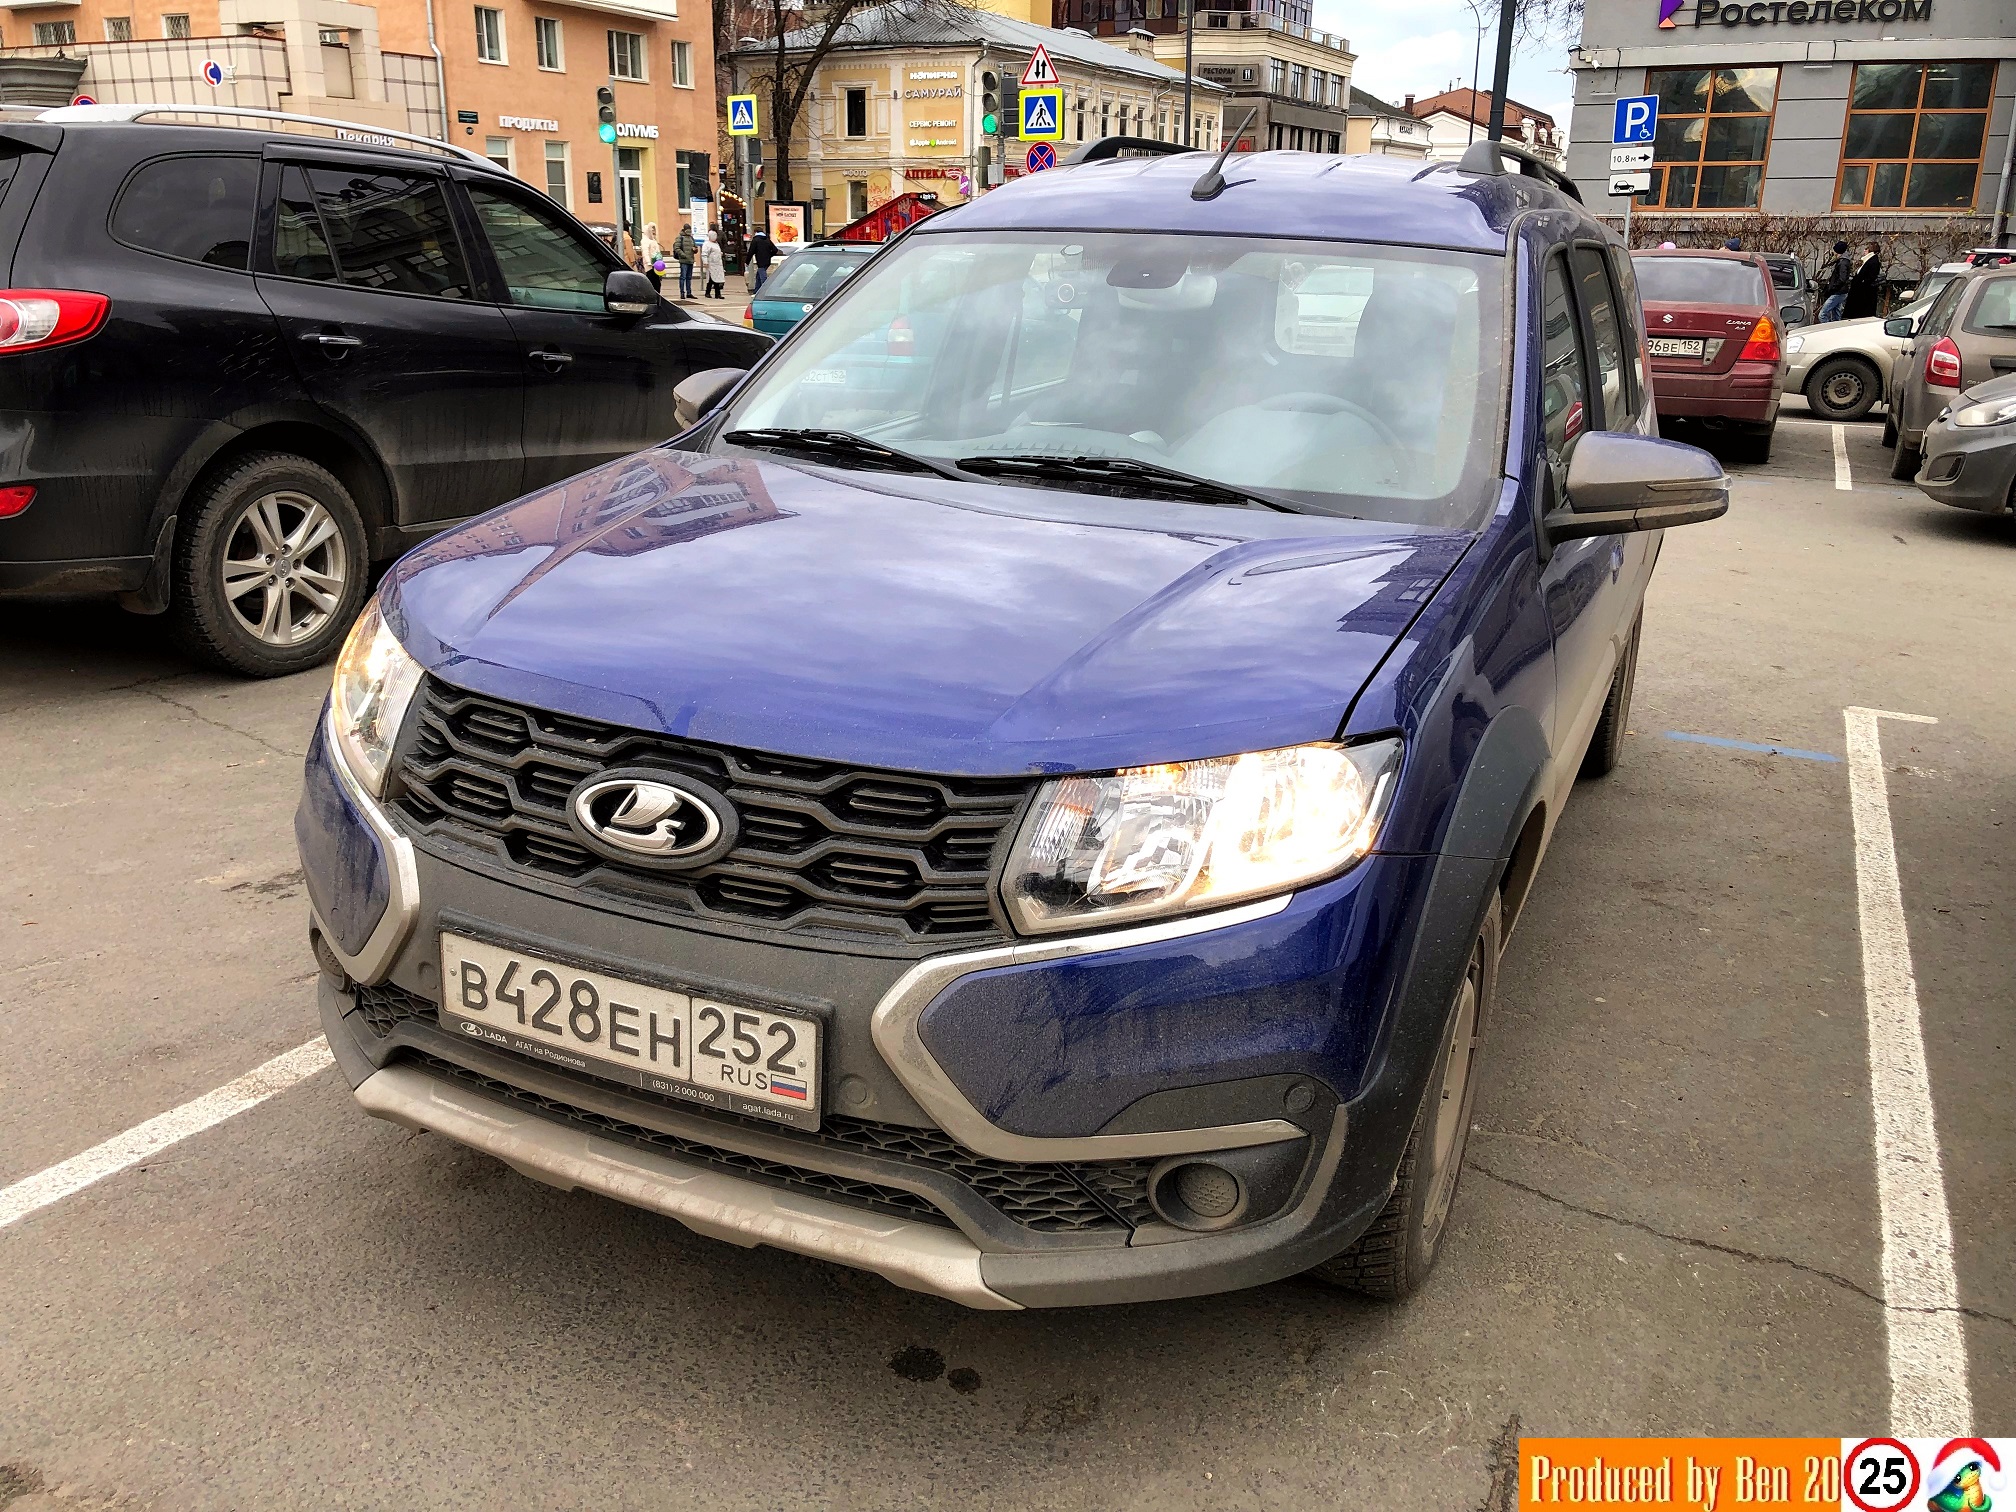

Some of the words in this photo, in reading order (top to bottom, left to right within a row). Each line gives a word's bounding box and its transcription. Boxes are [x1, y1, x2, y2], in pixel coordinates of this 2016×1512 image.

[1695, 0, 1932, 28] Ростелеком
[905, 84, 963, 99] САМУРАЙ
[499, 115, 559, 132] ПРОДУКТЫ
[910, 120, 931, 128] СЕРВИС
[932, 119, 957, 127] РЕМОНТ
[1624, 101, 1650, 139] P
[616, 122, 659, 139] ОЛУМБ
[904, 168, 947, 179] АПТЕКА
[1648, 339, 1679, 353] 96ВЕ
[1681, 340, 1700, 351] 152
[459, 958, 682, 1068] В428ЕН
[484, 1029, 508, 1044] LADA
[698, 1005, 797, 1076] 252
[515, 1040, 533, 1052] АГАТ
[534, 1047, 544, 1055] на
[544, 1048, 586, 1068] Родионова
[721, 1063, 768, 1091] RUS
[652, 1080, 673, 1093] (831)
[674, 1085, 681, 1094] 2
[681, 1087, 697, 1098] 000
[698, 1091, 715, 1102] 000
[742, 1102, 794, 1121] agat.lada.ru
